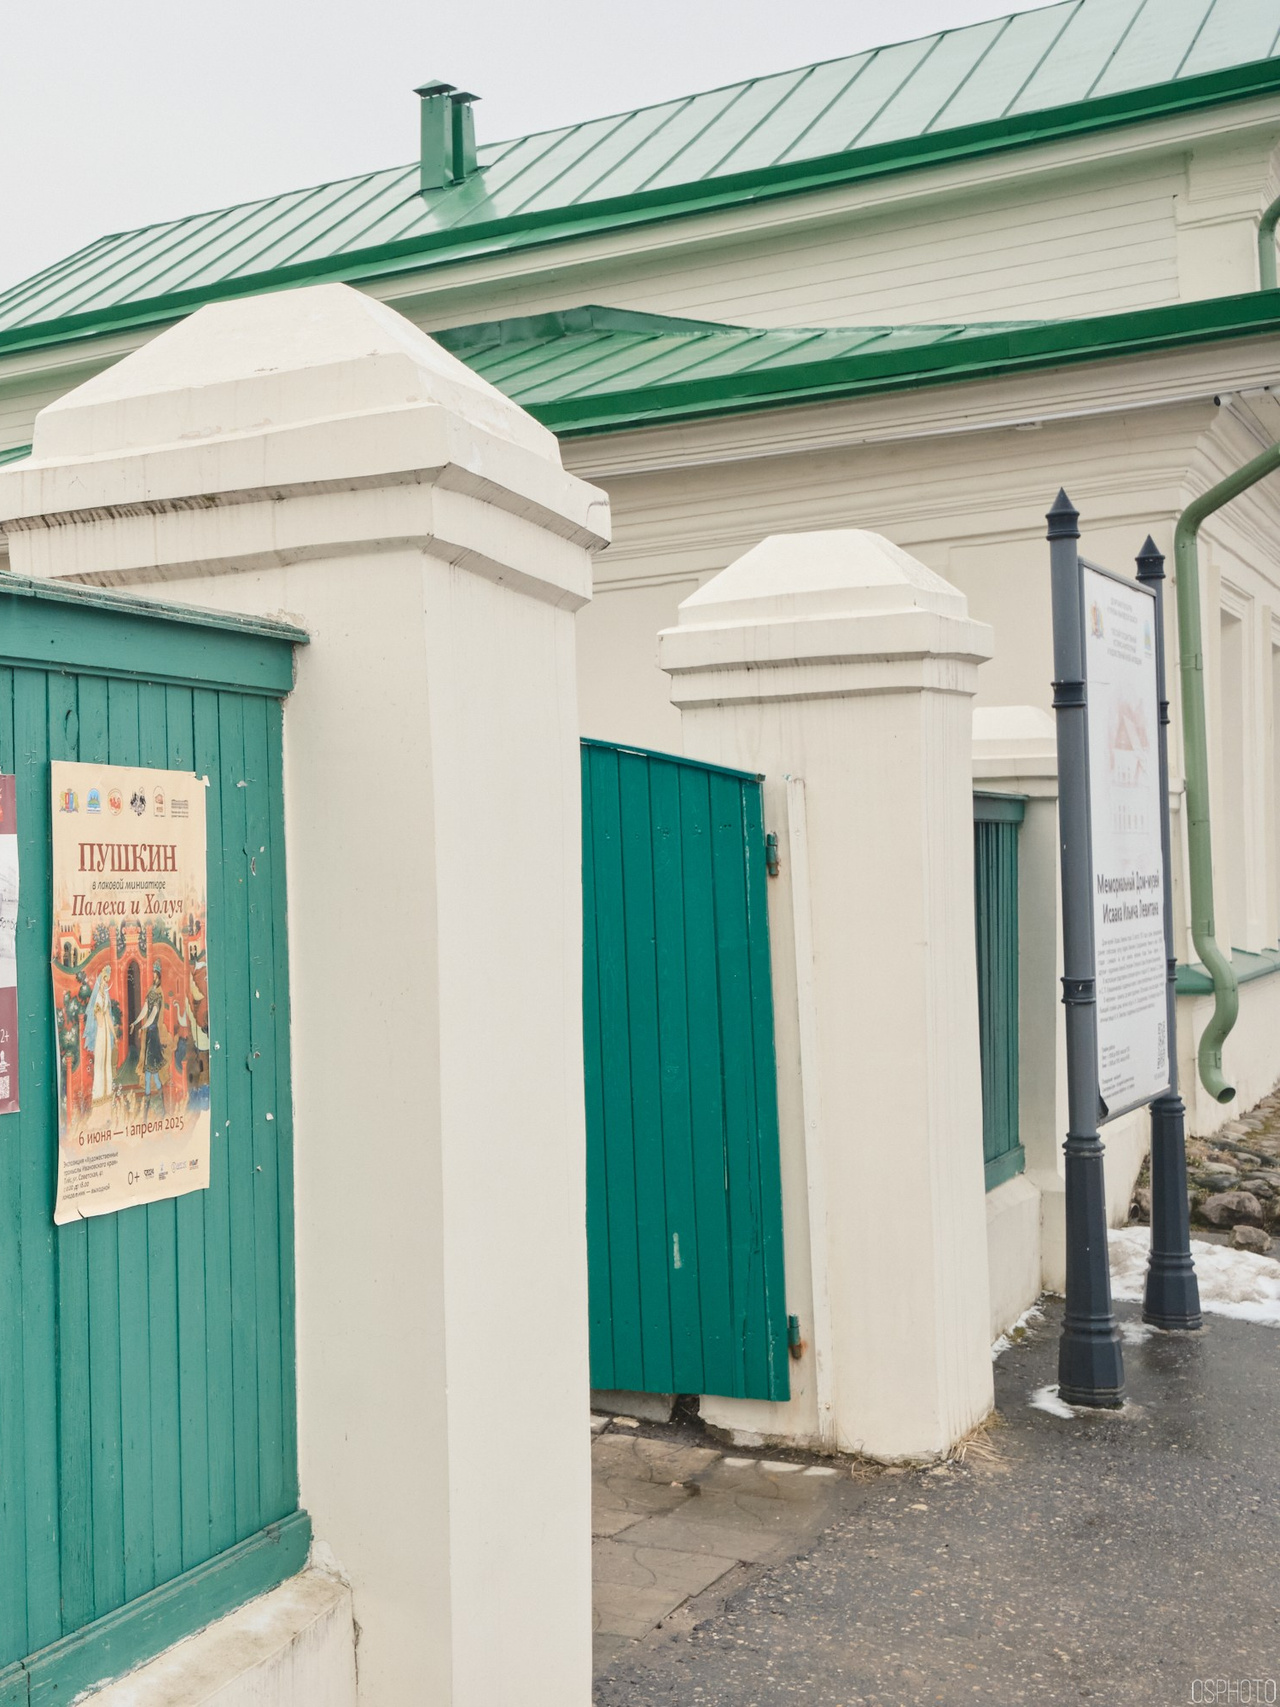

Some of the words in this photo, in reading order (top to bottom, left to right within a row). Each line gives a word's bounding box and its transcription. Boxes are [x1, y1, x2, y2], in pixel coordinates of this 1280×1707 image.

[78, 842, 178, 872] ПУШКИН
[92, 881, 96, 890] в
[98, 878, 124, 890] лаковой
[124, 880, 166, 892] миниатюре
[72, 894, 126, 916] Палеха
[130, 900, 140, 916] и
[144, 894, 184, 919] Холуя
[78, 1132, 84, 1146] 6
[86, 1128, 112, 1144] июня
[130, 1120, 163, 1138] апреля
[164, 1116, 184, 1130] 2025
